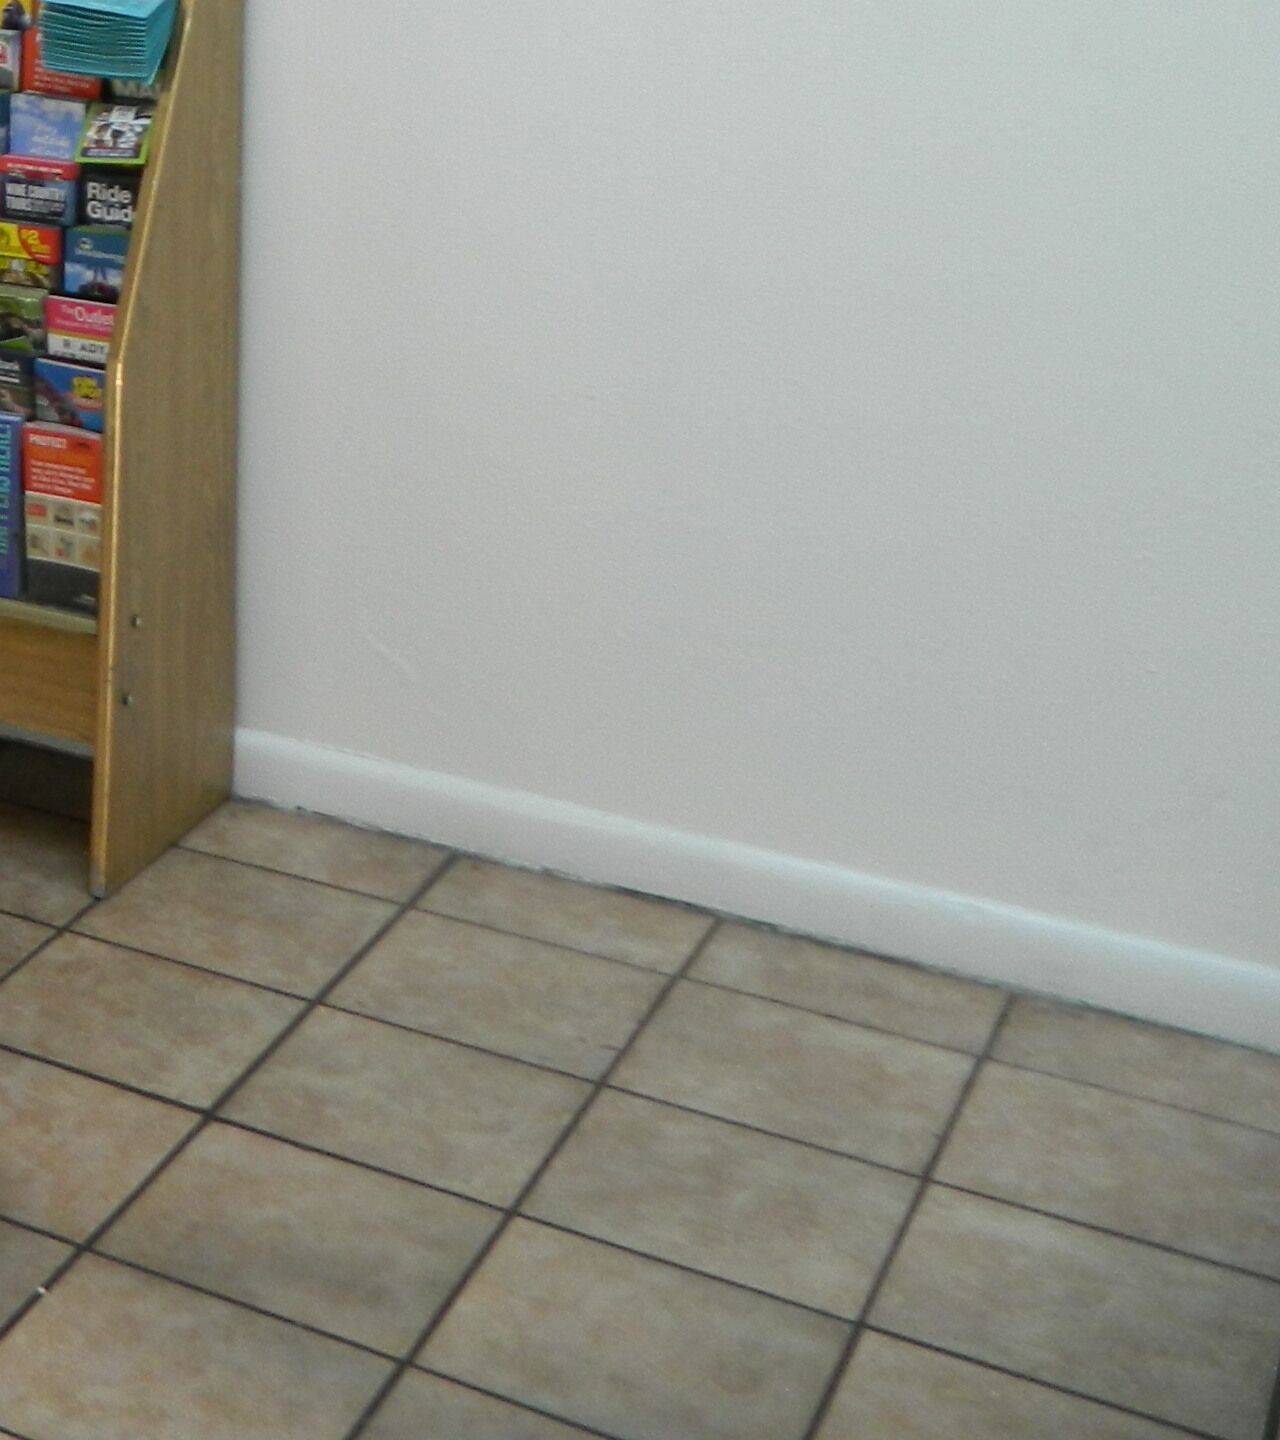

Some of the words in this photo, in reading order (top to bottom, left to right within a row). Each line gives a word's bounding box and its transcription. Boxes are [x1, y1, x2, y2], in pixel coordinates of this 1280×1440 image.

[86, 181, 132, 204] Ride
[86, 200, 133, 223] Guid
[74, 306, 113, 324] Outlet
